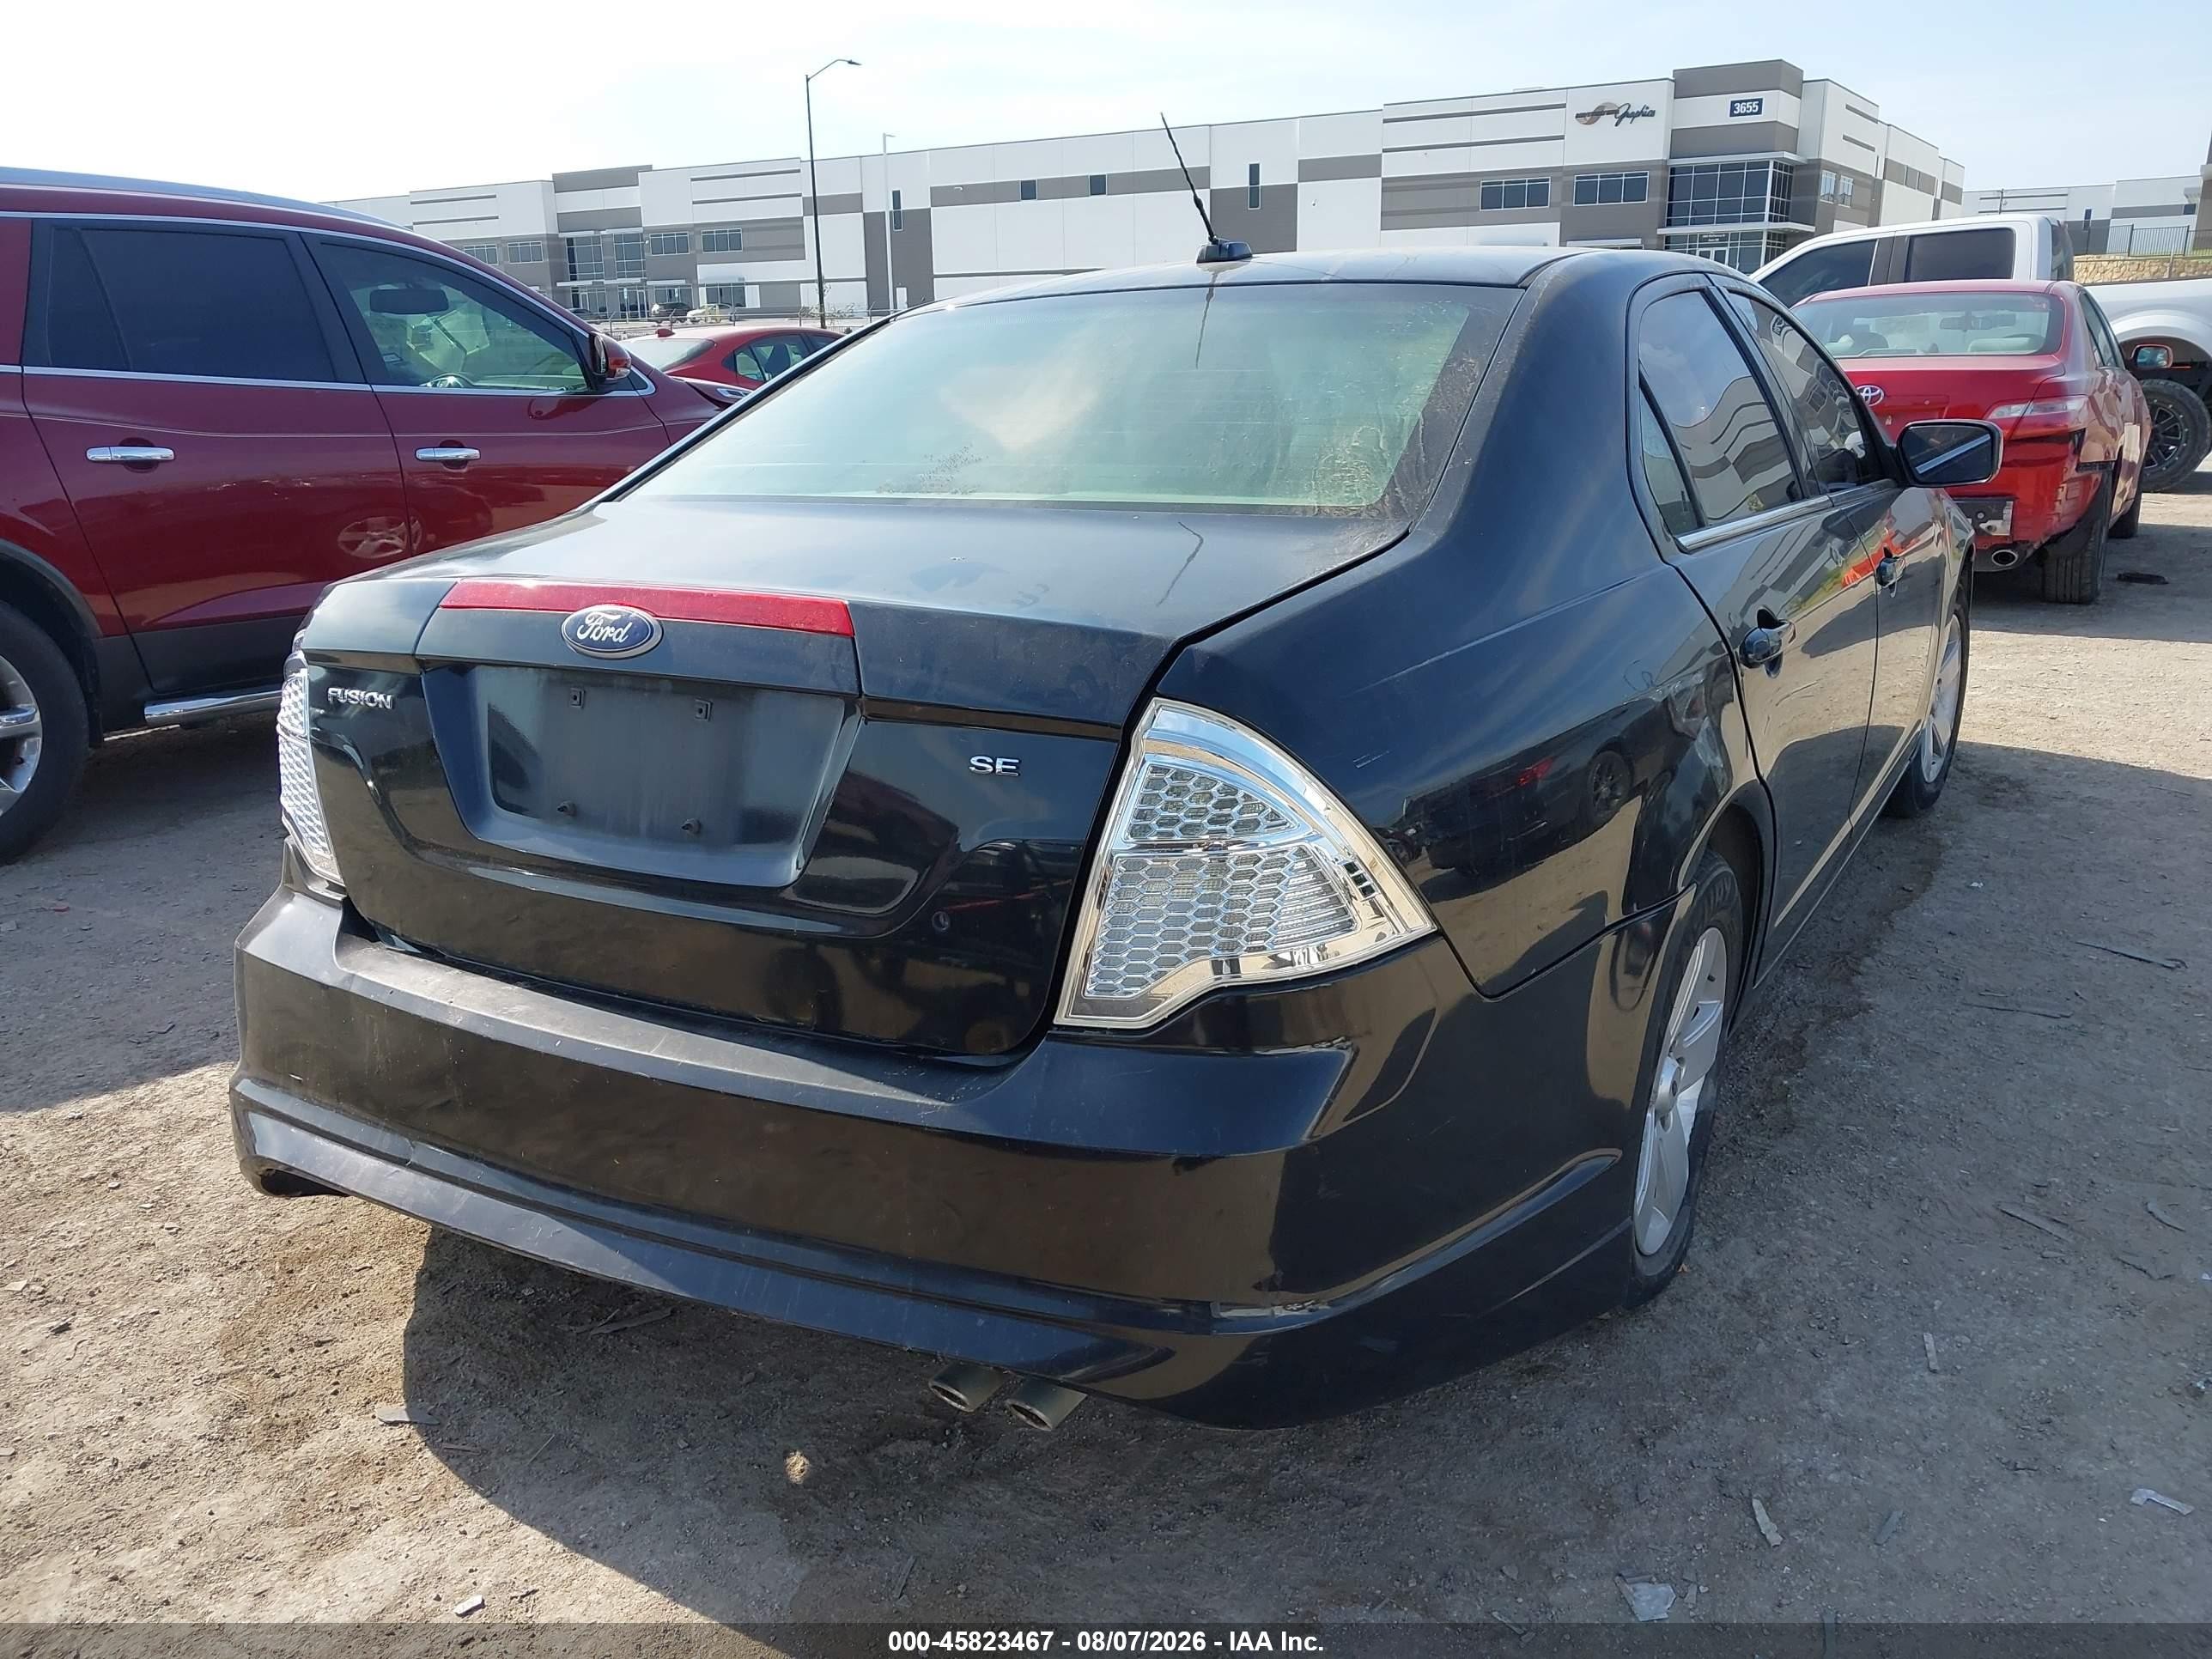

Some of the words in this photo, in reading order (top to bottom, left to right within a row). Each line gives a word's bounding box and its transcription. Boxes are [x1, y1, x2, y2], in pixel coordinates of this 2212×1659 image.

[1733, 100, 1759, 114] 3655
[577, 611, 633, 643] Ford
[328, 687, 393, 709] FUSION
[969, 756, 1019, 776] SE
